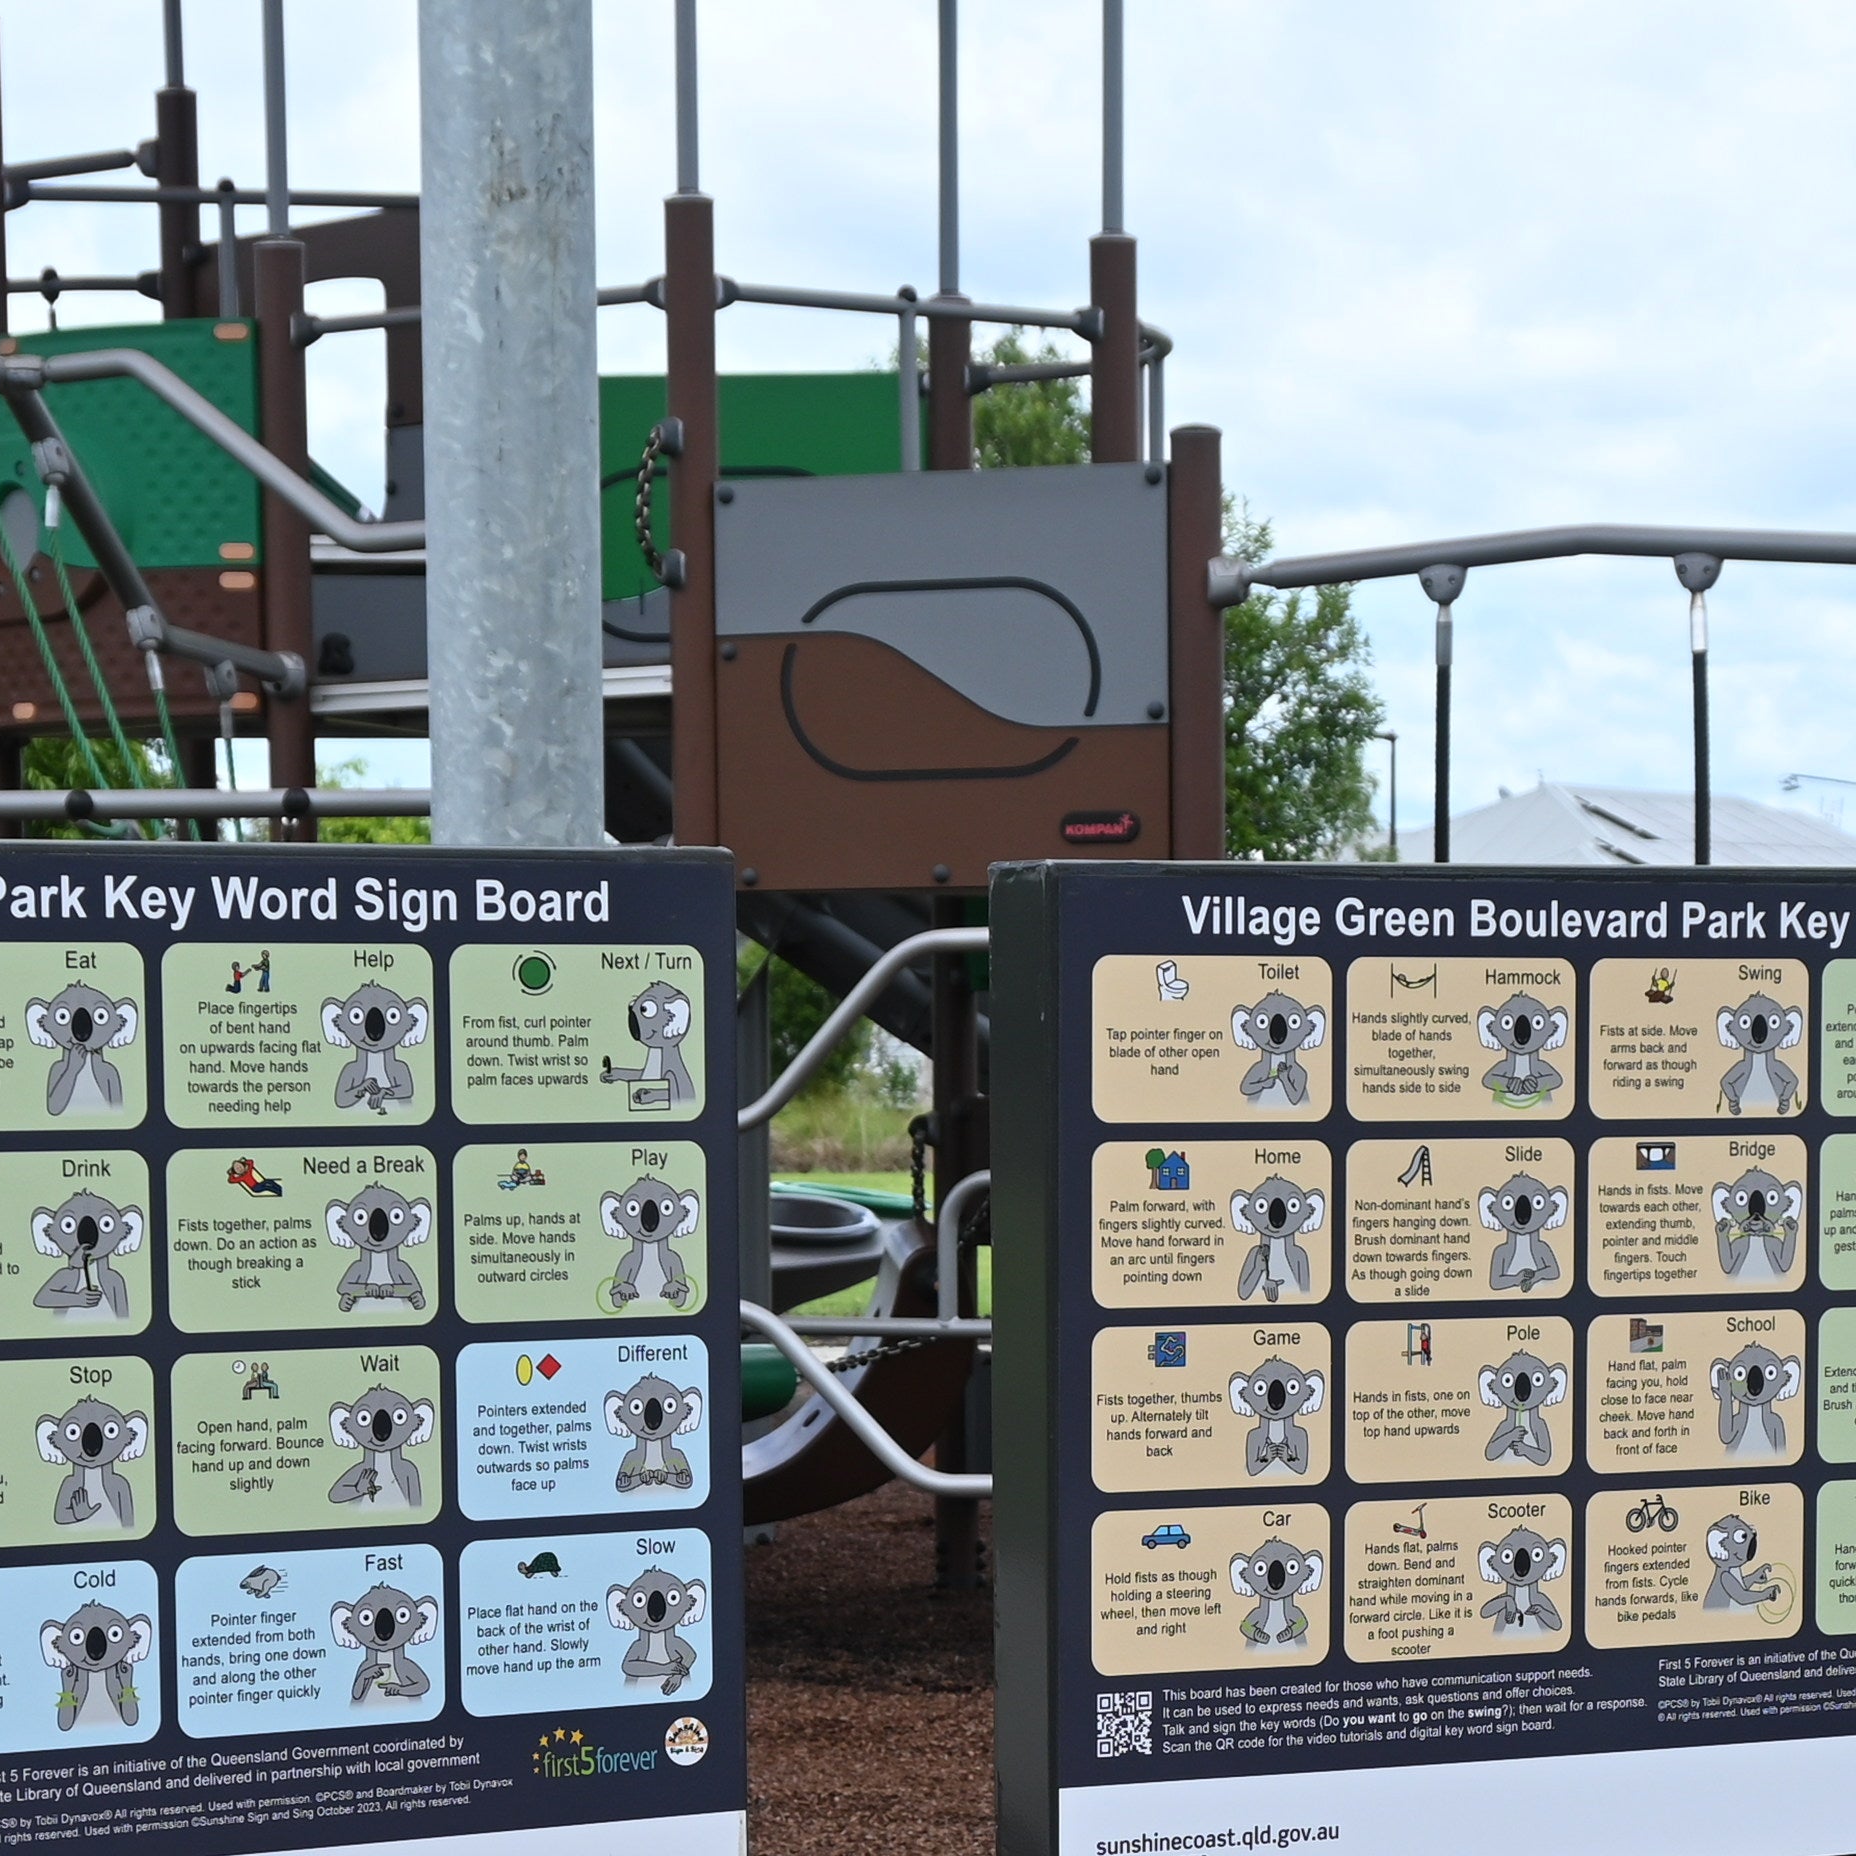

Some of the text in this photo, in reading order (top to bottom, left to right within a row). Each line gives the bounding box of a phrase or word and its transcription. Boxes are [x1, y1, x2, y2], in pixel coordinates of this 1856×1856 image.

[104, 874, 196, 931] Key
[210, 876, 337, 920] Word
[354, 876, 457, 932] Sign
[475, 878, 609, 922] Board
[1181, 895, 1321, 946] Village
[1335, 896, 1454, 937] Green
[1470, 898, 1667, 939] Boulevard
[1682, 901, 1766, 939] Park
[1779, 901, 1850, 949] Key
[65, 950, 97, 969] Eat
[353, 949, 394, 972] Help
[601, 951, 640, 970] Next
[654, 951, 692, 970] Turn
[1257, 962, 1300, 980] Toilet
[1485, 968, 1561, 985] Hammock
[1738, 964, 1782, 984] Swing
[197, 1000, 297, 1018] Place fingertips
[462, 1014, 591, 1031] From fist, curl pointer
[1105, 1027, 1223, 1043] Tap pointer finger on
[631, 1148, 668, 1170] Play
[1254, 1147, 1301, 1165] Home
[1504, 1145, 1542, 1162] Slide
[1728, 1140, 1776, 1160] Bridge
[62, 1158, 111, 1177] Drink
[303, 1154, 425, 1175] Need a Break
[1506, 1324, 1540, 1341] Pole
[1726, 1315, 1775, 1333] School
[1253, 1329, 1301, 1346] Game
[618, 1343, 688, 1363] Different
[359, 1353, 400, 1372] Wait
[69, 1365, 112, 1387] Stop
[1096, 1391, 1223, 1408] Fists together, thumbs
[1352, 1389, 1470, 1403] Hands in fists, one on
[1739, 1489, 1770, 1506] Bike
[1262, 1510, 1292, 1527] Car
[1487, 1502, 1546, 1519] Scooter
[636, 1537, 676, 1556] Slow
[365, 1553, 403, 1572] Fast
[73, 1568, 116, 1589] Cold
[1105, 1568, 1217, 1585] Hold fists as though
[1616, 1608, 1676, 1623] bike pedals
[1096, 1824, 1339, 1856] sunshinecoast.qld.gov.au
